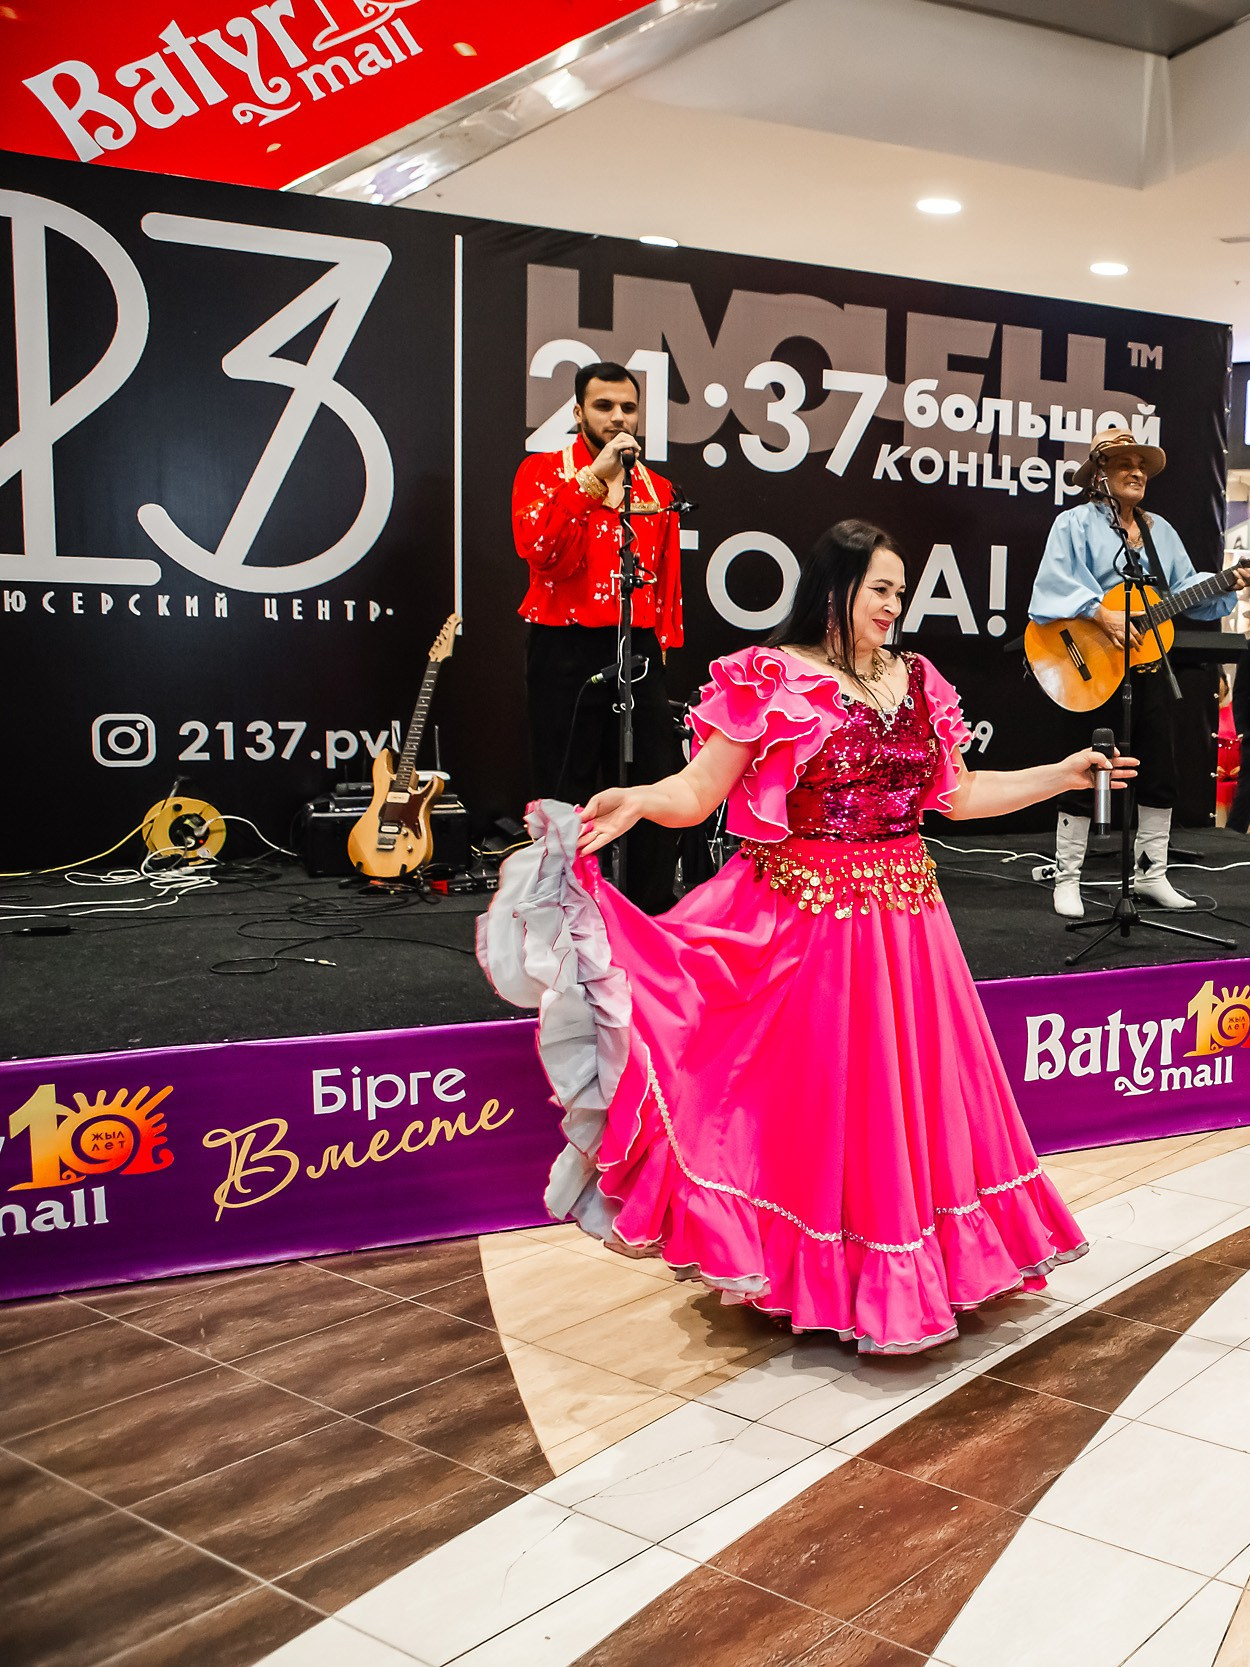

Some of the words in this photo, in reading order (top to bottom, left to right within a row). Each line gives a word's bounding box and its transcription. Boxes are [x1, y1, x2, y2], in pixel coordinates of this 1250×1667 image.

[22, 0, 307, 162] Batyr
[297, 18, 423, 101] mall
[873, 443, 1084, 506] концер
[312, 1066, 467, 1121] Бірге
[1024, 1009, 1185, 1096] Batyr
[1160, 1055, 1233, 1092] mall
[202, 1098, 515, 1222] Вместе
